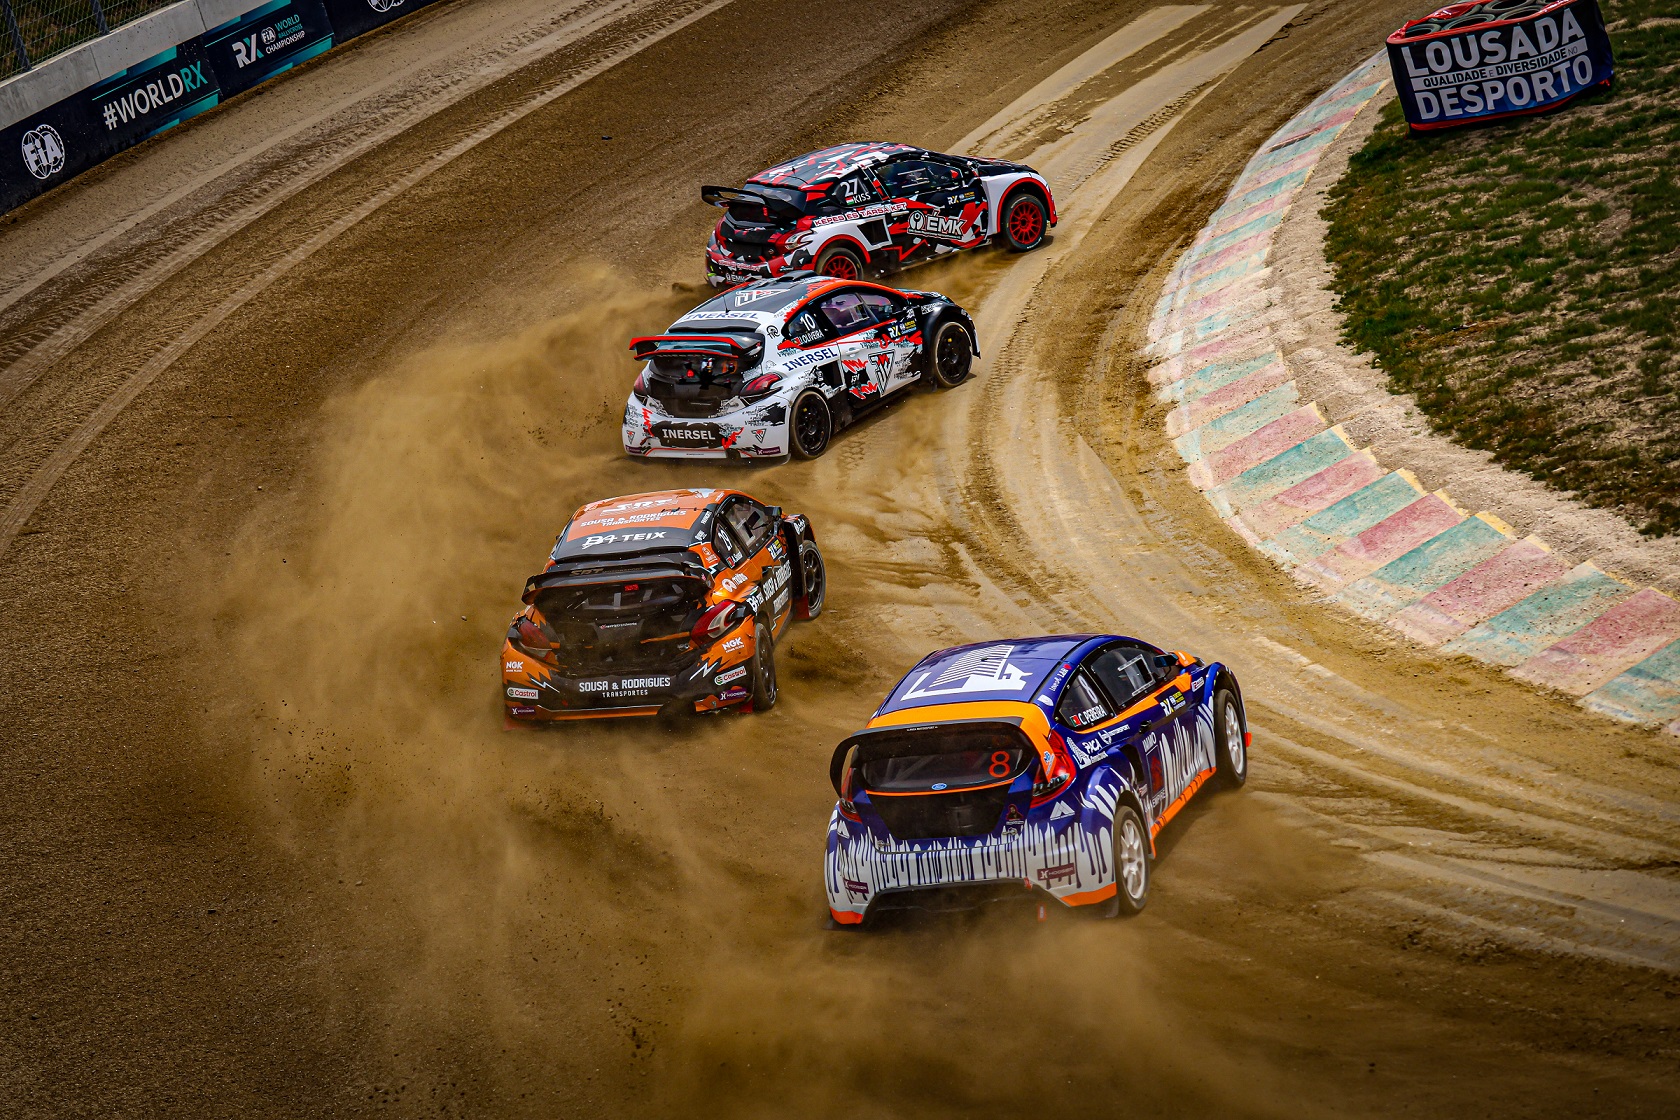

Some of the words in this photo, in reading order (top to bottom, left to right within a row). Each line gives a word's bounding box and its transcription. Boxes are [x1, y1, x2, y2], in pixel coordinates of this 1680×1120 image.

[274, 14, 300, 32] WORLD
[278, 23, 303, 39] RALLYCROSS
[231, 33, 264, 68] RX
[265, 30, 306, 55] CHAMPIONSHIP
[1401, 8, 1585, 77] LOUSADA
[1423, 68, 1488, 88] QUALIDADE
[1488, 69, 1495, 77] E
[1495, 47, 1568, 76] DIVERSIDADE
[1568, 45, 1578, 56] NO
[103, 60, 208, 131] #WORLDRX
[1414, 55, 1593, 120] DESPORTO
[840, 178, 859, 197] 27
[853, 191, 871, 204] KISS
[926, 209, 965, 236] ÉMK
[684, 312, 759, 320] INERSEL
[800, 313, 816, 331] 10
[887, 324, 901, 339] RX
[782, 347, 838, 372] INERSEL
[661, 428, 716, 440] INERSEL
[580, 517, 615, 527] SOUSA
[629, 510, 687, 521] RODRIGUES
[602, 516, 661, 527] TRANSPORTES
[621, 531, 667, 543] TEIX
[721, 636, 744, 651] NGK
[506, 661, 524, 670] NGK
[723, 668, 746, 681] Castrol
[579, 681, 609, 692] SOUSA
[612, 682, 619, 690] &
[621, 677, 671, 690] RODRIGUES
[1077, 674, 1099, 704] 8
[514, 689, 537, 698] Castrol
[602, 689, 649, 698] TRANSPORTES
[988, 750, 1011, 778] 8
